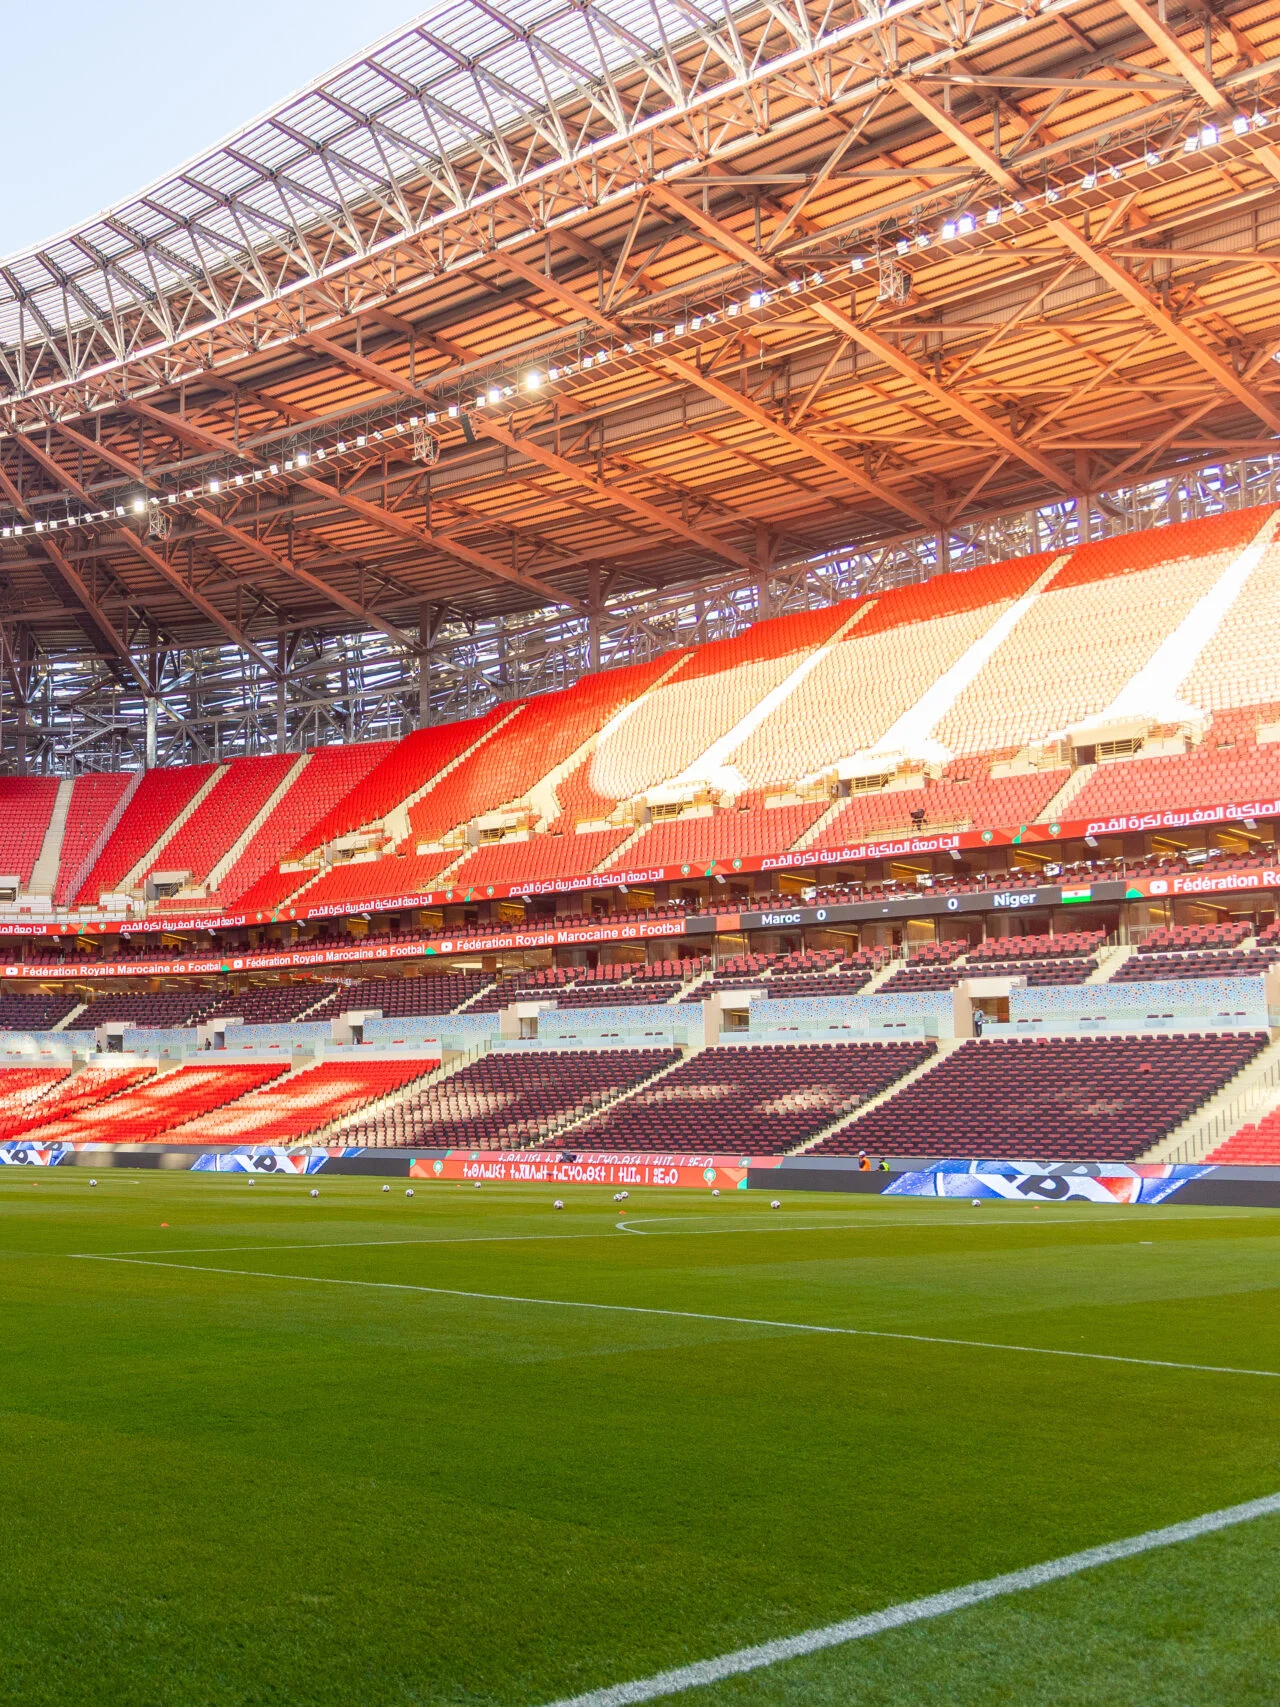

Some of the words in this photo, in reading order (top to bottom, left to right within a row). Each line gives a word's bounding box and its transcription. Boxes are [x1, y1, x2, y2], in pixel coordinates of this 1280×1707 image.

[1129, 814, 1161, 831] لكرة
[1163, 806, 1223, 827] المغربية
[1085, 817, 1126, 837] القدم
[820, 846, 865, 863] المغربية
[868, 841, 909, 858] الملكية
[761, 855, 792, 871] القدم
[794, 852, 818, 866] لكرة
[535, 881, 554, 894] لكرة
[556, 877, 591, 891] المغربية
[593, 873, 625, 887] الملكية
[1174, 874, 1258, 892] Fédération
[509, 883, 533, 897] القدم
[308, 906, 328, 919] القدم
[761, 912, 801, 926] Maroc
[816, 909, 826, 921] 0
[948, 898, 957, 910] 0
[993, 892, 1037, 909] Niger
[120, 922, 142, 933] القدم
[457, 937, 512, 951] Fédération
[516, 935, 554, 947] Royale
[558, 929, 618, 943] Marocaine
[622, 926, 636, 937] de
[246, 953, 290, 968] Fédération
[293, 950, 323, 965] Royale
[326, 948, 373, 961] Marocaine
[376, 948, 387, 957] de
[23, 966, 77, 976] Fédération
[80, 966, 114, 977] Royale
[118, 963, 170, 975] Marocaine
[173, 963, 185, 972] de
